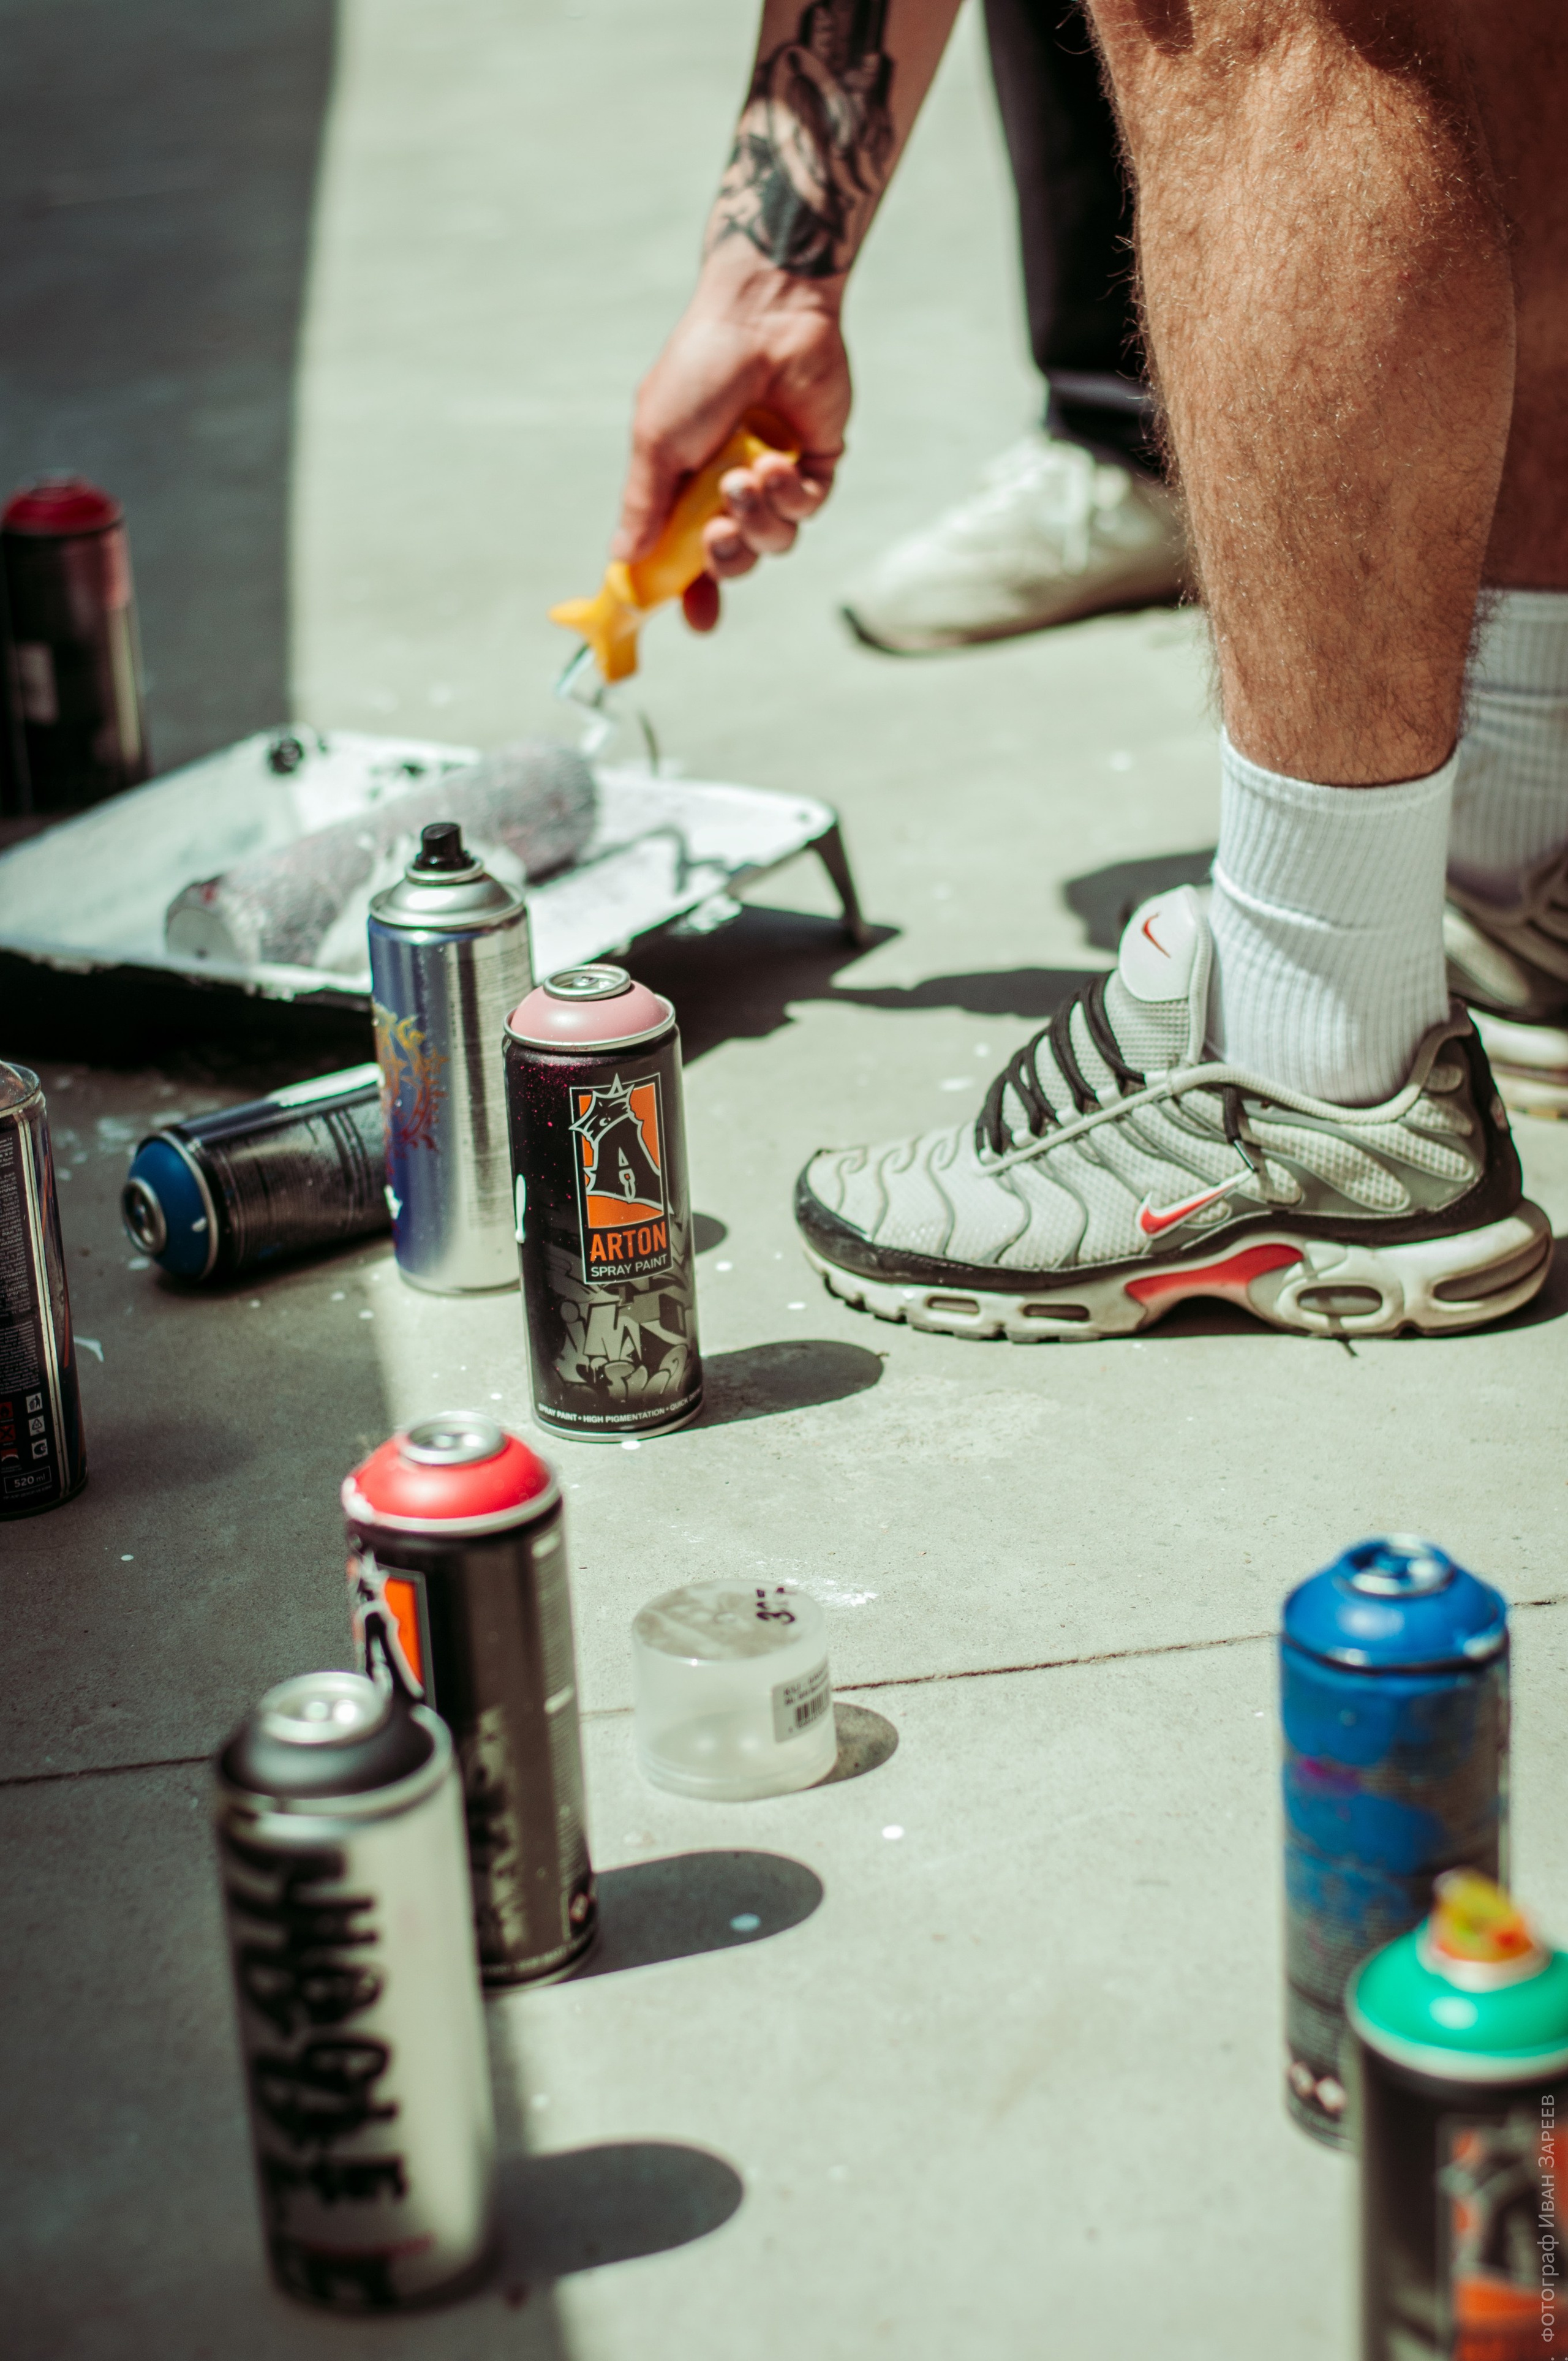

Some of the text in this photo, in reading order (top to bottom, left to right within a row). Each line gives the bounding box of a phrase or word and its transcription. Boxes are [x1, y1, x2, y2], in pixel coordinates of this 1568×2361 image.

[590, 1221, 667, 1262] ARTON
[591, 1254, 668, 1277] SPRAY PAINT
[557, 1410, 578, 1421] PAINT
[606, 1407, 665, 1423] PIGMENTATION
[669, 1397, 688, 1410] QUICK
[14, 1473, 45, 1488] 520 ml
